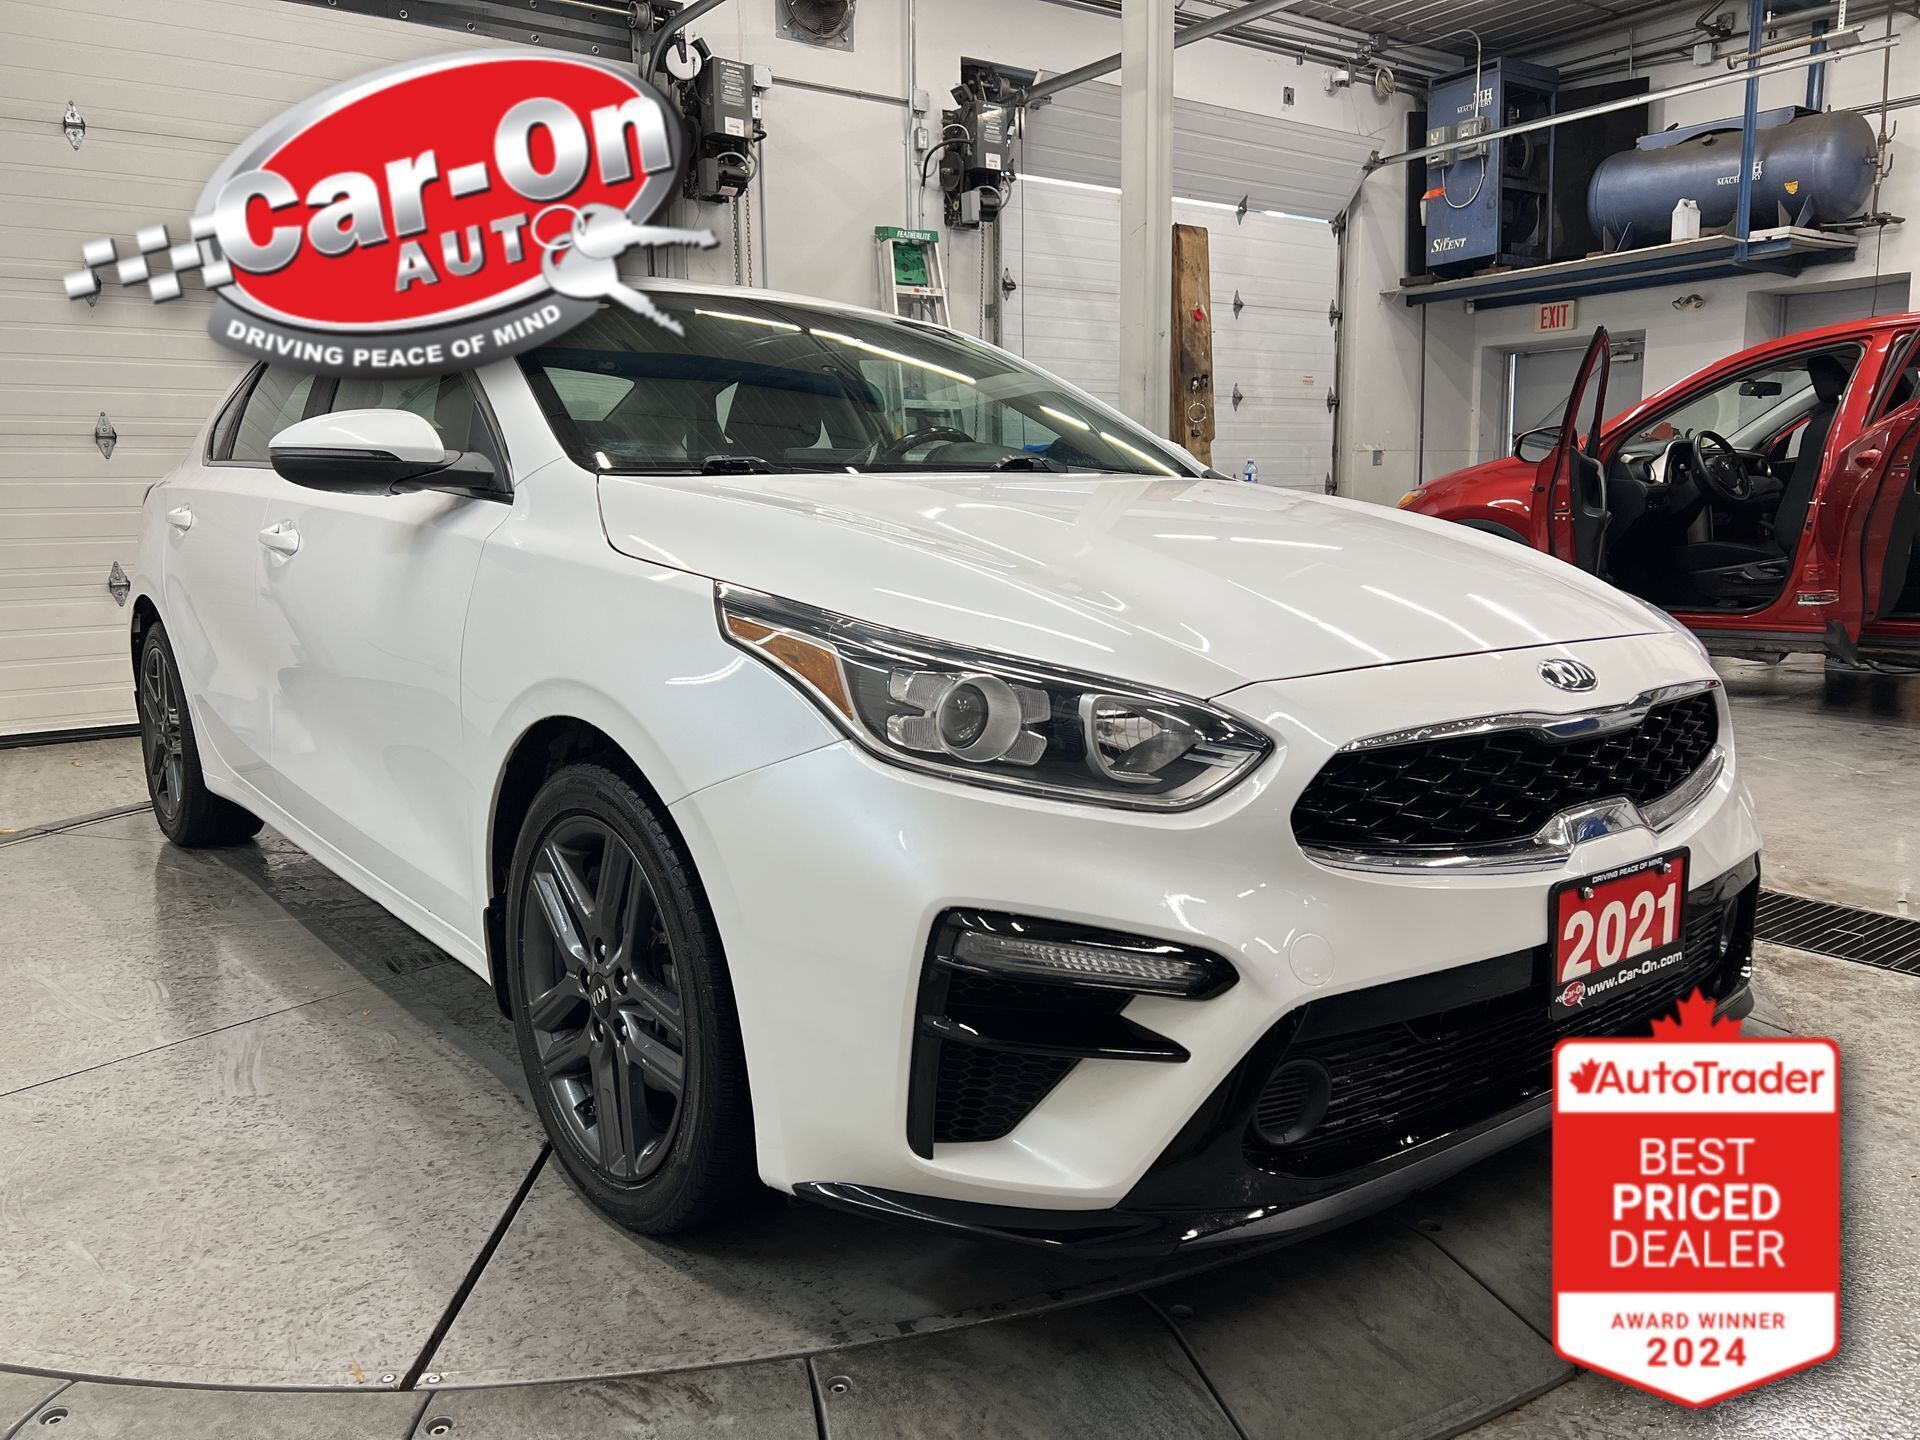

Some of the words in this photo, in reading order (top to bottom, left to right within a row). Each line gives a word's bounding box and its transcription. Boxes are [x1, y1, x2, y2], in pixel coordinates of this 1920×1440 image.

[1717, 172, 1762, 186] MACHRY
[897, 231, 930, 240] FEATHERLITE
[1541, 304, 1569, 329] EXIT
[1592, 870, 1618, 883] DRIVING
[1619, 864, 1639, 876] PEACE
[1640, 861, 1648, 870] OF
[1648, 857, 1663, 867] MIND
[1561, 882, 1676, 983] 2021
[1587, 951, 1683, 996] www.Car-On.com
